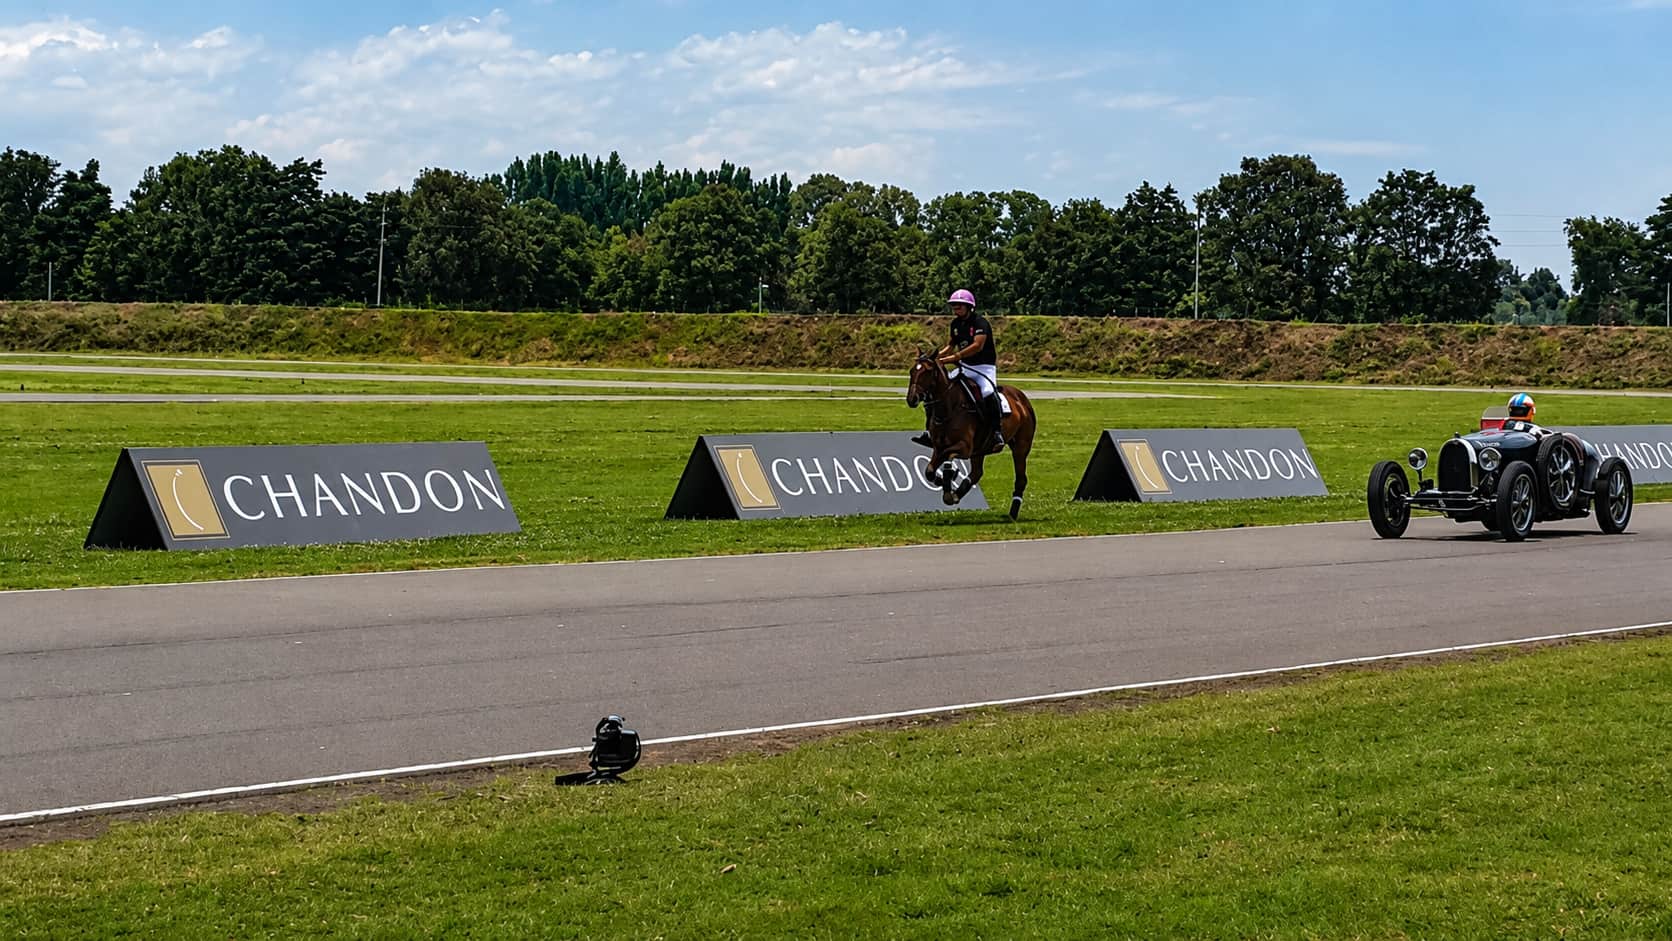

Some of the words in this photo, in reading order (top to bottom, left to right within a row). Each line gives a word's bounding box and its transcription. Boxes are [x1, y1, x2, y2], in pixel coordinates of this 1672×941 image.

[1161, 448, 1319, 483] CHANDON
[1595, 442, 1672, 470] HANDO
[223, 469, 506, 521] CHANDON
